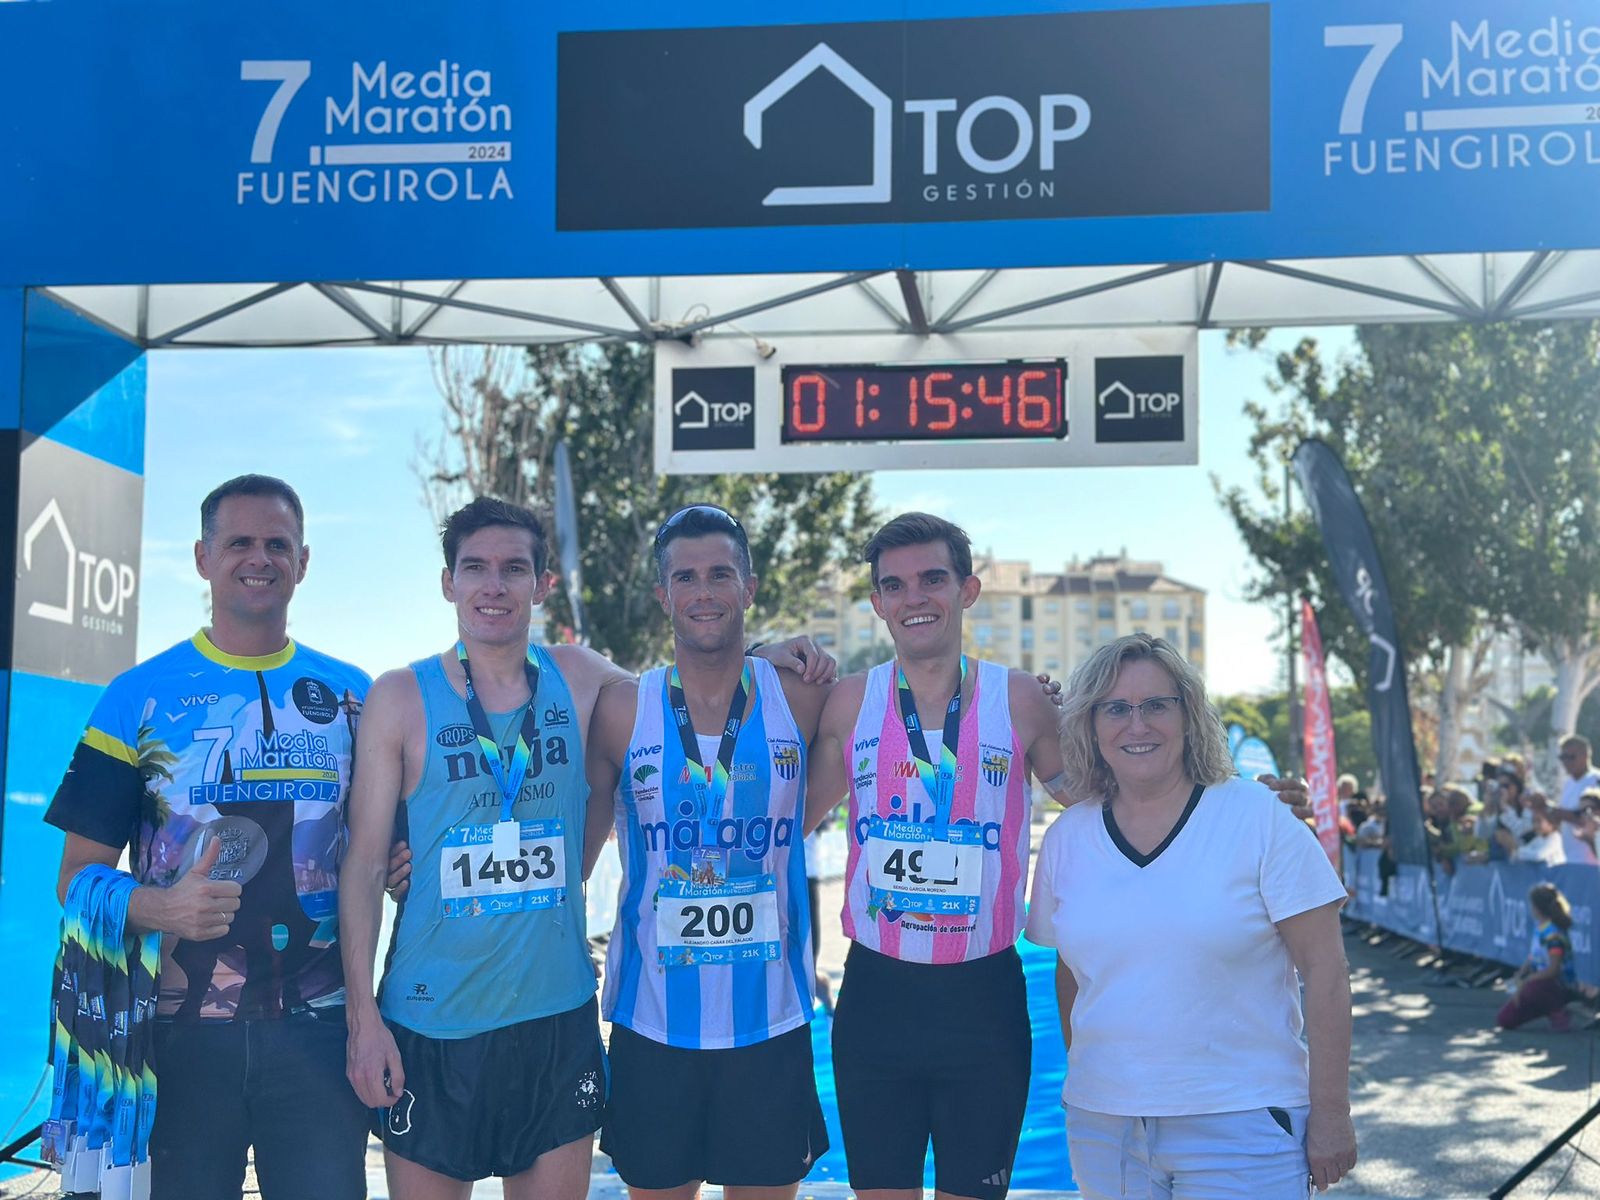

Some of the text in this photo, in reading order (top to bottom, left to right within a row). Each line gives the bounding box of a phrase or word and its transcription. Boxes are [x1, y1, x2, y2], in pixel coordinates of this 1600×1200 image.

[352, 59, 491, 100] Media
[1421, 56, 1600, 98] Marató
[325, 97, 512, 134] Maratón
[904, 93, 1091, 174] TOP
[468, 146, 506, 159] 2024
[1324, 130, 1600, 176] FUENGIROL
[237, 167, 514, 205] FUENGIROLA
[923, 179, 1054, 201] GESTIÓN
[792, 370, 1051, 432] 01:15:46
[1136, 393, 1180, 412] TOP
[710, 402, 752, 423] TOP
[78, 551, 135, 617] TOP
[82, 615, 124, 636] GESTIÓN
[180, 693, 220, 707] vive
[256, 730, 328, 750] Media
[438, 728, 477, 747] TROPS
[855, 737, 879, 752] vive
[240, 748, 338, 770] Maratón
[631, 744, 663, 760] vive
[191, 782, 339, 804] FUENGIROLA
[468, 781, 555, 810] ATLISMO
[460, 828, 470, 843] 7
[469, 833, 494, 843] Mara
[640, 799, 794, 861] máaga
[883, 822, 890, 837] 7
[888, 829, 926, 841] Maratón
[893, 823, 922, 833] Media
[452, 845, 556, 887] 1463
[884, 848, 958, 886] 49
[678, 881, 687, 895] 7
[685, 887, 722, 896] Maratón
[531, 895, 550, 905] 21K
[942, 901, 960, 910] 21K
[680, 902, 754, 938] 200
[900, 920, 937, 933] Agrupación
[940, 925, 948, 933] de
[742, 949, 759, 958] 21K
